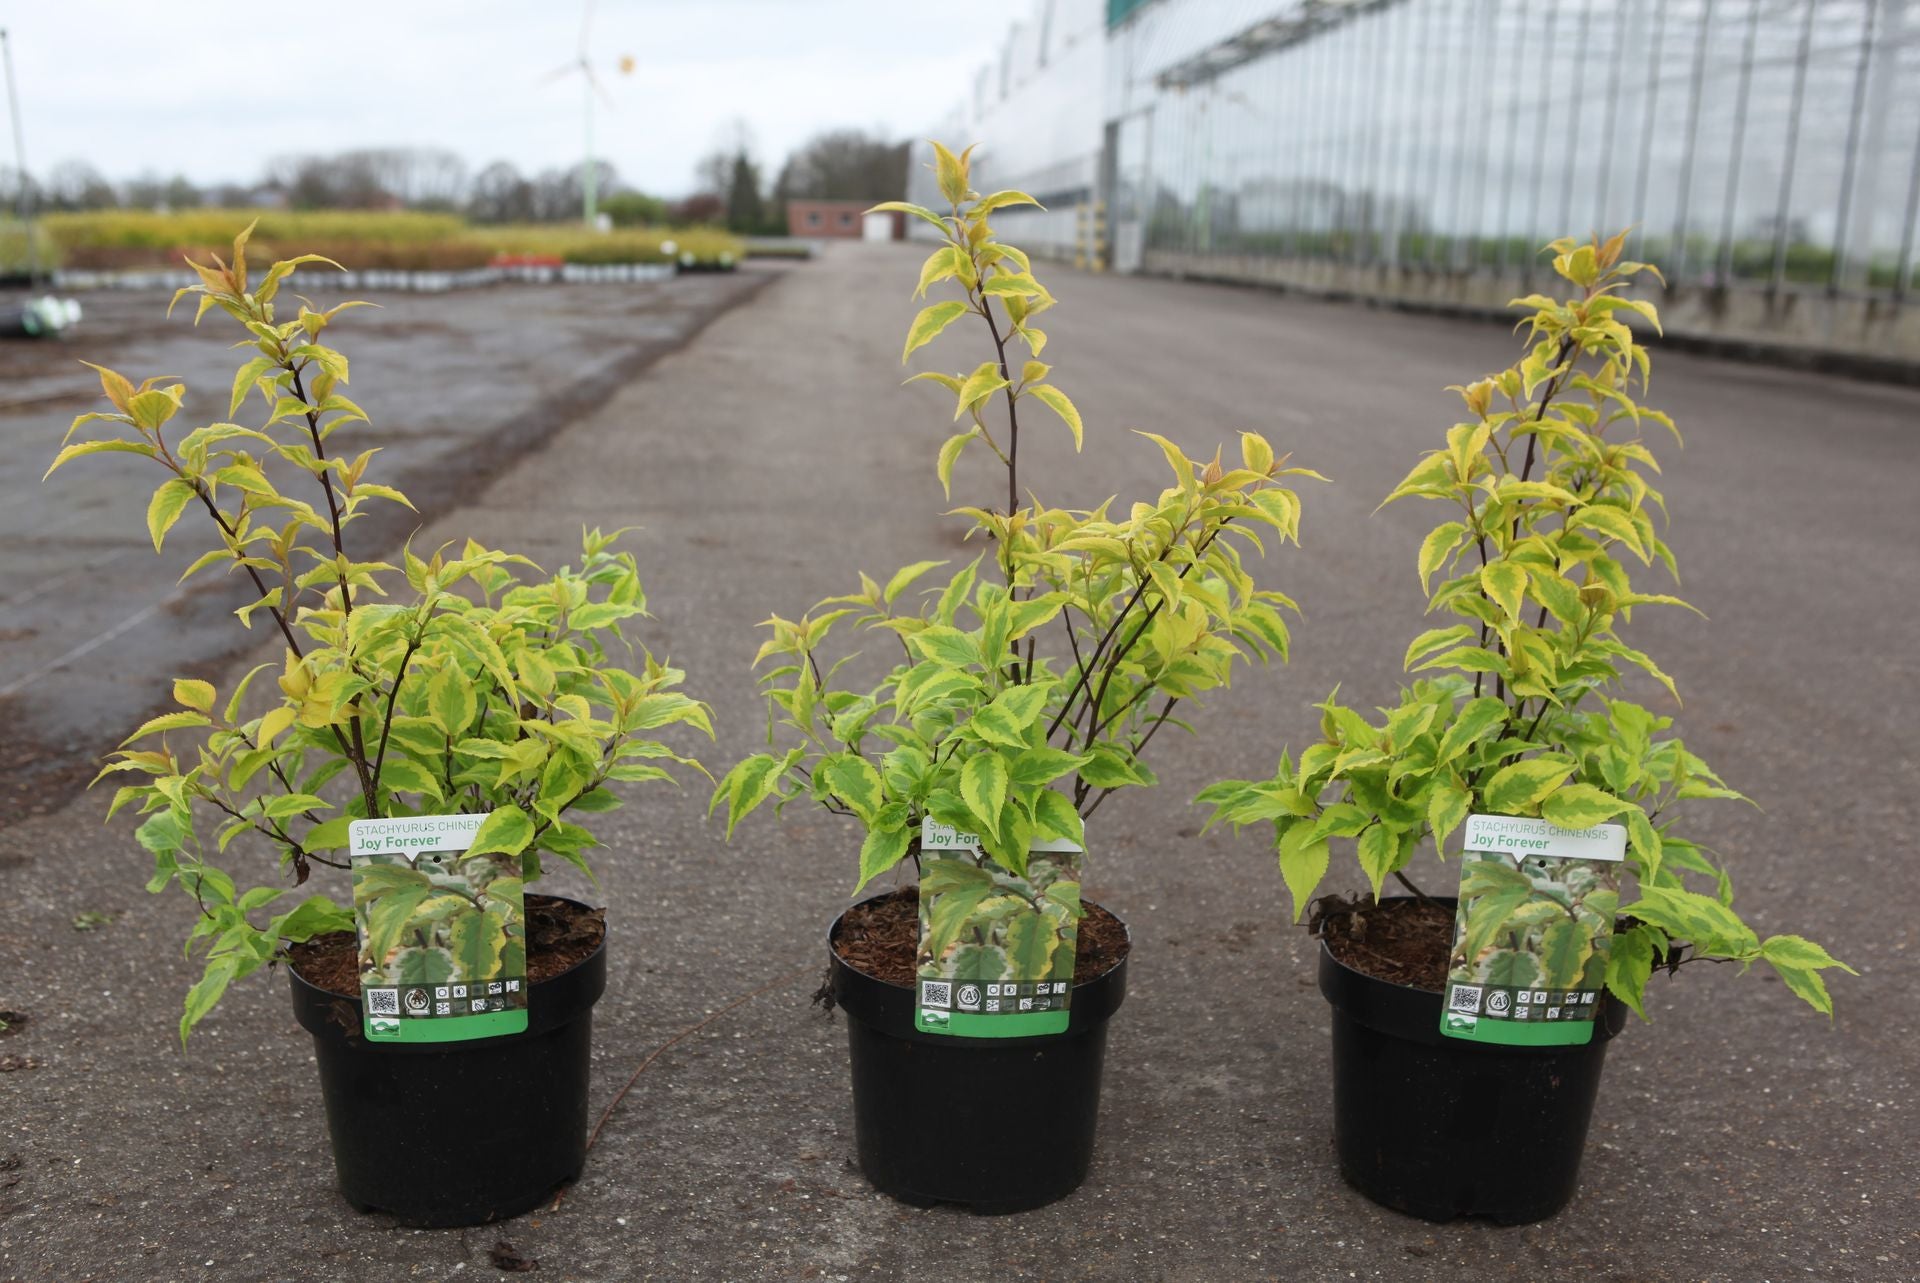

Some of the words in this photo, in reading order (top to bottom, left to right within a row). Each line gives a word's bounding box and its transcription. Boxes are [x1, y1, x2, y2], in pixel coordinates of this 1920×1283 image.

[356, 822, 435, 836] STACHYURUS
[438, 820, 483, 831] CHINEN
[1472, 820, 1546, 836] STACHYURUS
[1549, 826, 1609, 840] CHINENSIS
[358, 838, 382, 851] Joy
[386, 835, 441, 848] Forever
[929, 832, 952, 846] Joy
[1471, 833, 1494, 848] Joy
[1498, 835, 1550, 849] Forever
